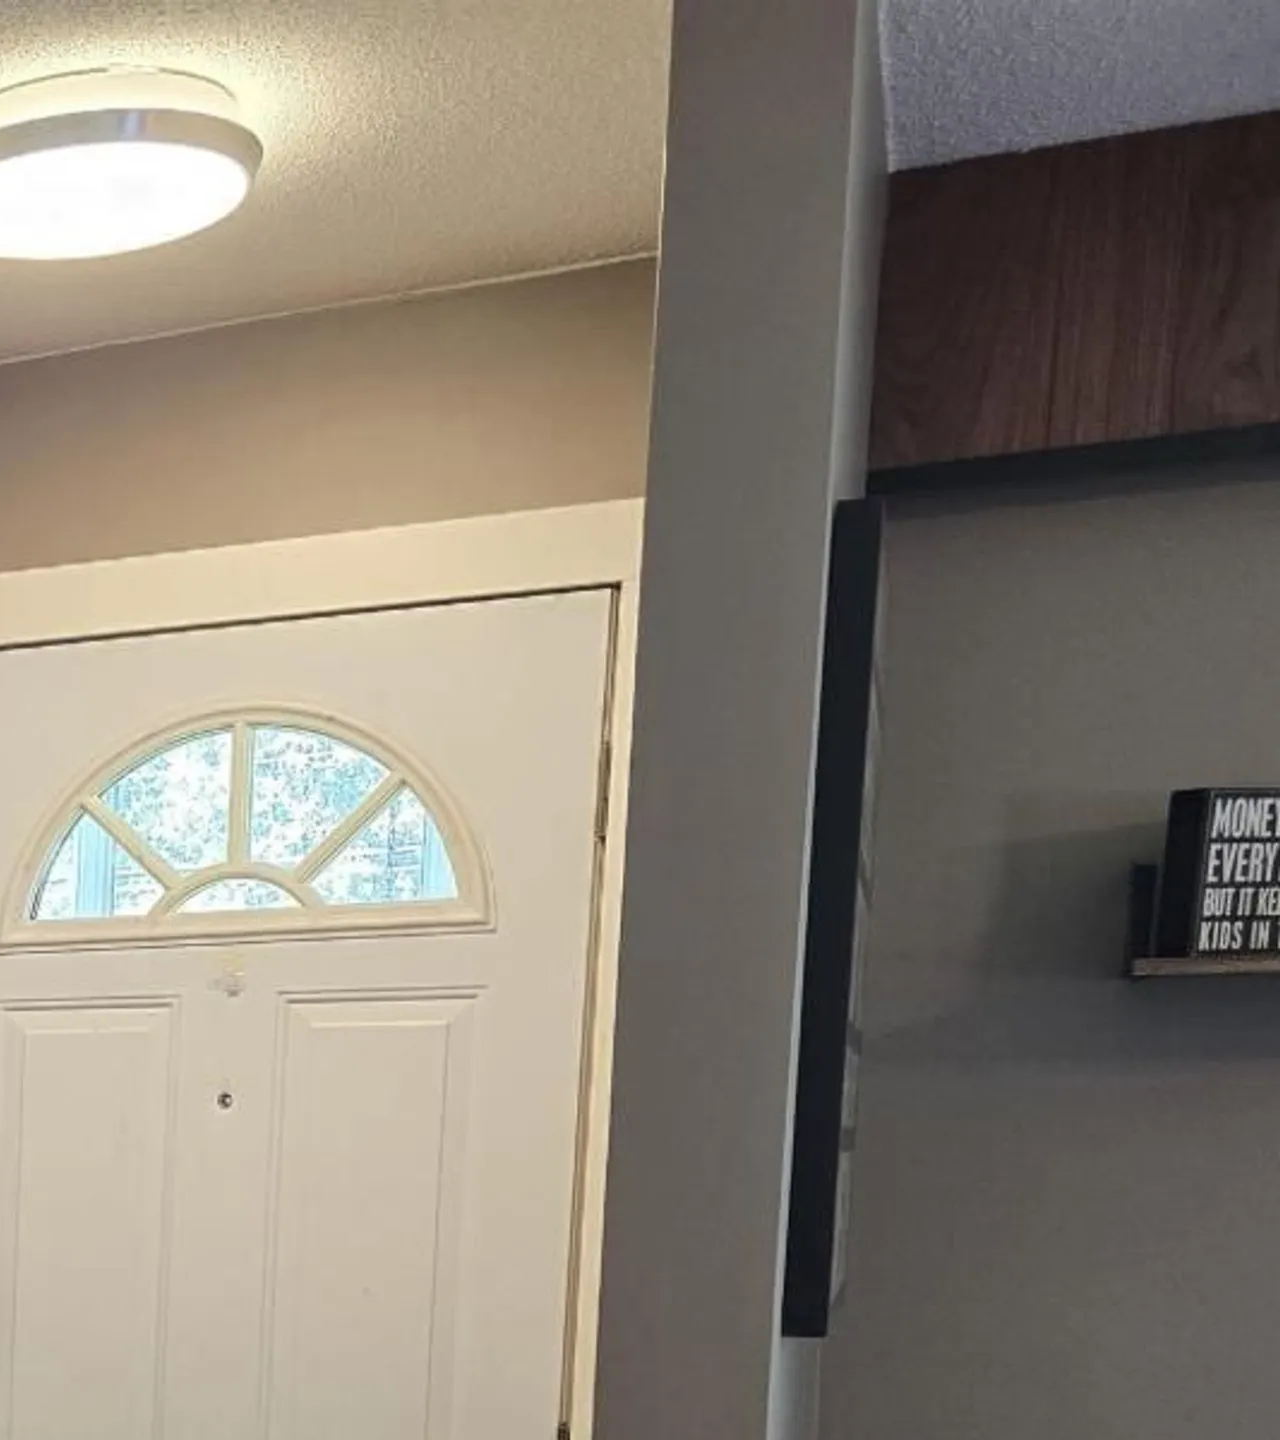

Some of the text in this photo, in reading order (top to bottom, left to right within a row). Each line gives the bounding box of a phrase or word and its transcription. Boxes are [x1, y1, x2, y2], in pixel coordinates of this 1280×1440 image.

[1206, 842, 1279, 883] EVERY
[1203, 887, 1236, 917] BUT
[1237, 887, 1256, 917] IT
[1198, 920, 1244, 952] KIDS
[1249, 921, 1271, 950] IN
